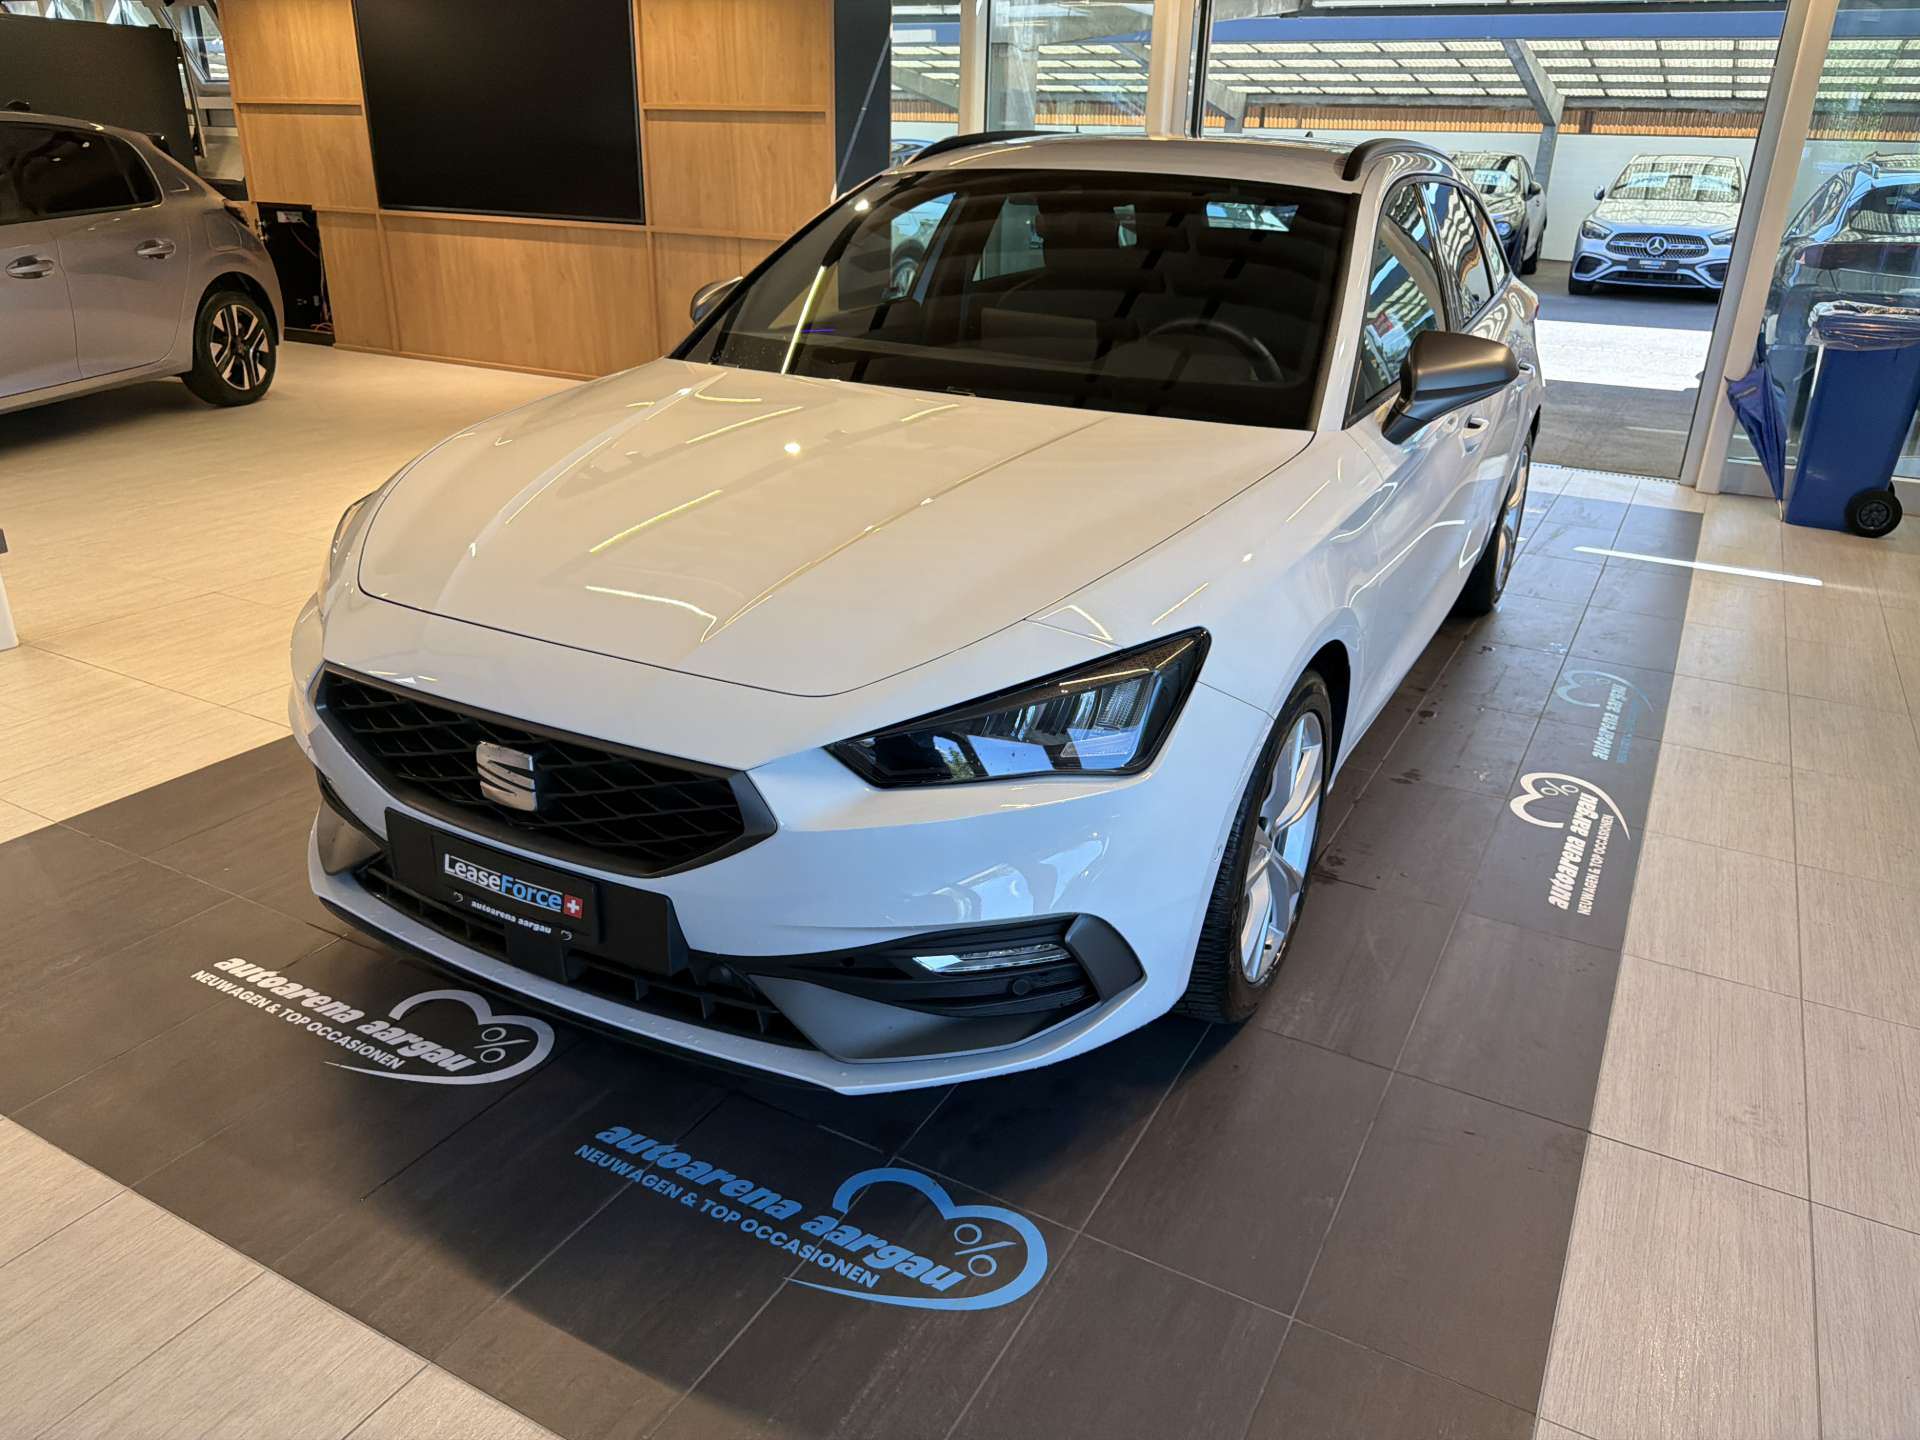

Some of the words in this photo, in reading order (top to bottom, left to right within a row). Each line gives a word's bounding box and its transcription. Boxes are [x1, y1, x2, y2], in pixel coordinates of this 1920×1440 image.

[1548, 835, 1586, 910] autoarena
[1570, 792, 1599, 838] aargau
[1589, 854, 1604, 868] TOP
[1593, 814, 1615, 855] OCCASIONEN
[444, 853, 563, 909] LeaseForce
[471, 900, 516, 923] autoarena
[517, 917, 552, 934] aargau
[1577, 874, 1600, 916] NEUWAGEN
[191, 969, 272, 1013] NEUWAGEN
[264, 1003, 279, 1014] &
[278, 1007, 312, 1026] TOP
[306, 1021, 406, 1070] OCCASIONEN
[213, 956, 366, 1024] autoarena
[357, 1017, 477, 1072] aargau
[575, 1144, 683, 1200] NEUWAGEN
[680, 1191, 699, 1208] &
[699, 1199, 743, 1225] TOP
[739, 1218, 881, 1289] OCCASIONEN
[594, 1126, 803, 1222] autoarena
[800, 1212, 967, 1292] aargau
